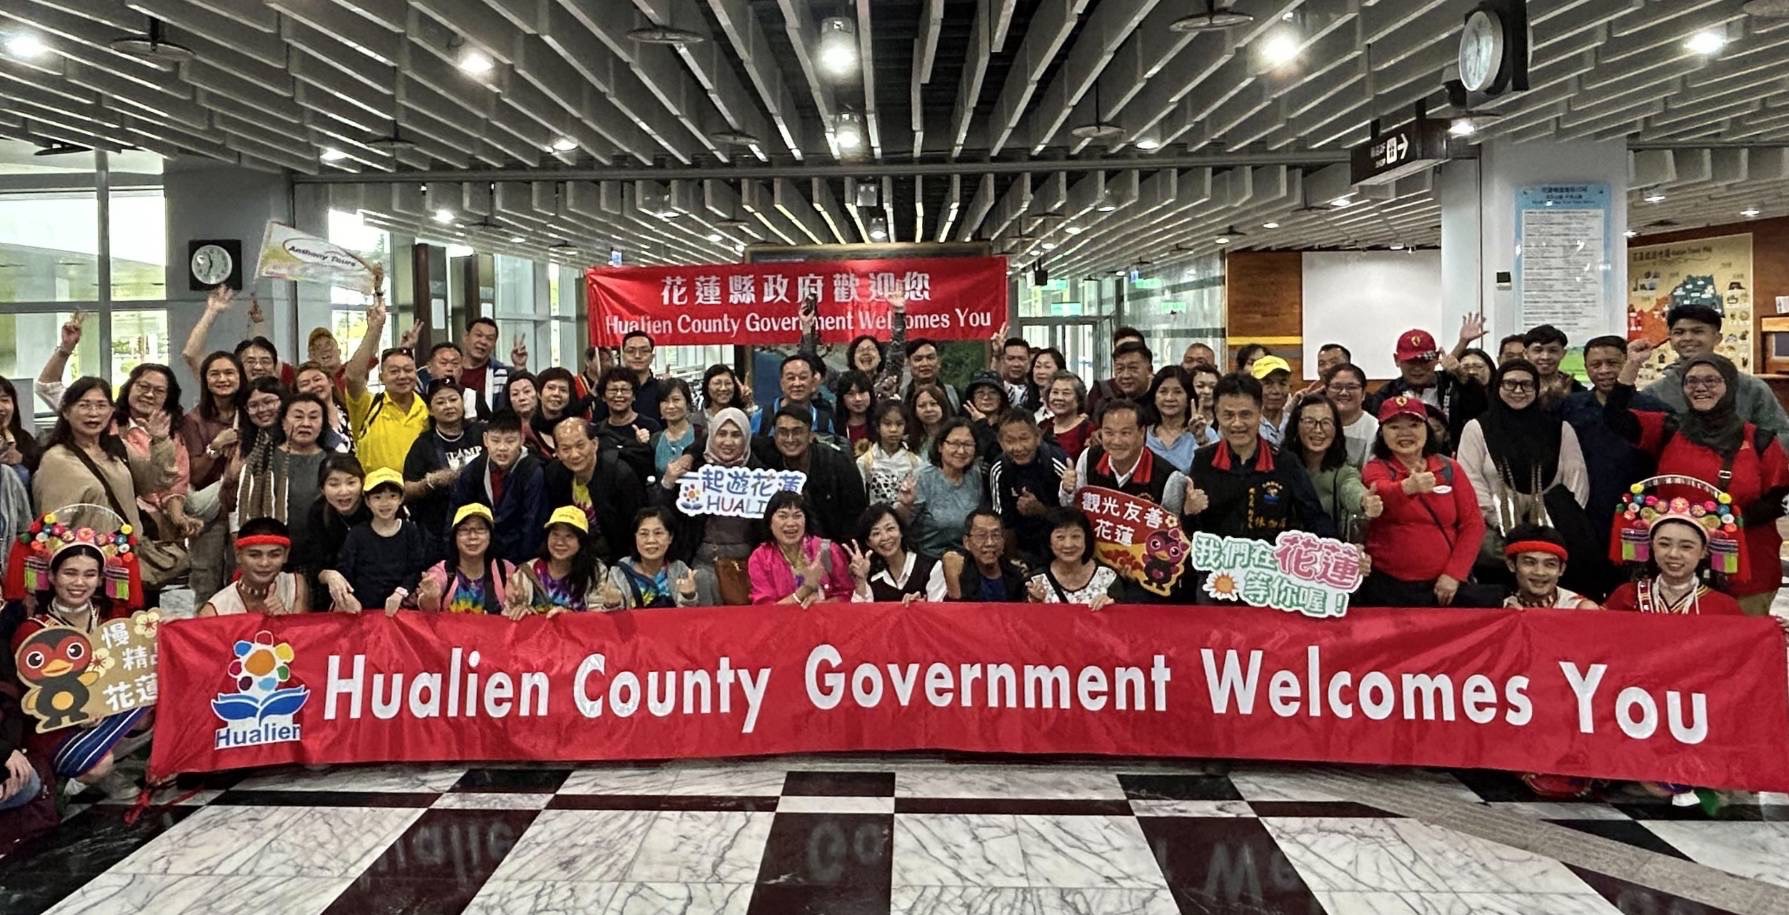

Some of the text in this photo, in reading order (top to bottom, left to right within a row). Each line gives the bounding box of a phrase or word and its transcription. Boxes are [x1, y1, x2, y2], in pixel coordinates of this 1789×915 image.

[288, 245, 356, 267] Anthony Tours
[661, 271, 931, 306] 花蓮縣政府歡迎您
[605, 307, 991, 337] Hualien County Goverment Welomes You
[706, 495, 768, 515] HUALI
[1082, 491, 1164, 529] 觀光友善
[1094, 518, 1135, 547] 花蓮
[324, 644, 1709, 745] Hualien County Government Welcomes You
[215, 723, 302, 748] Hualien
